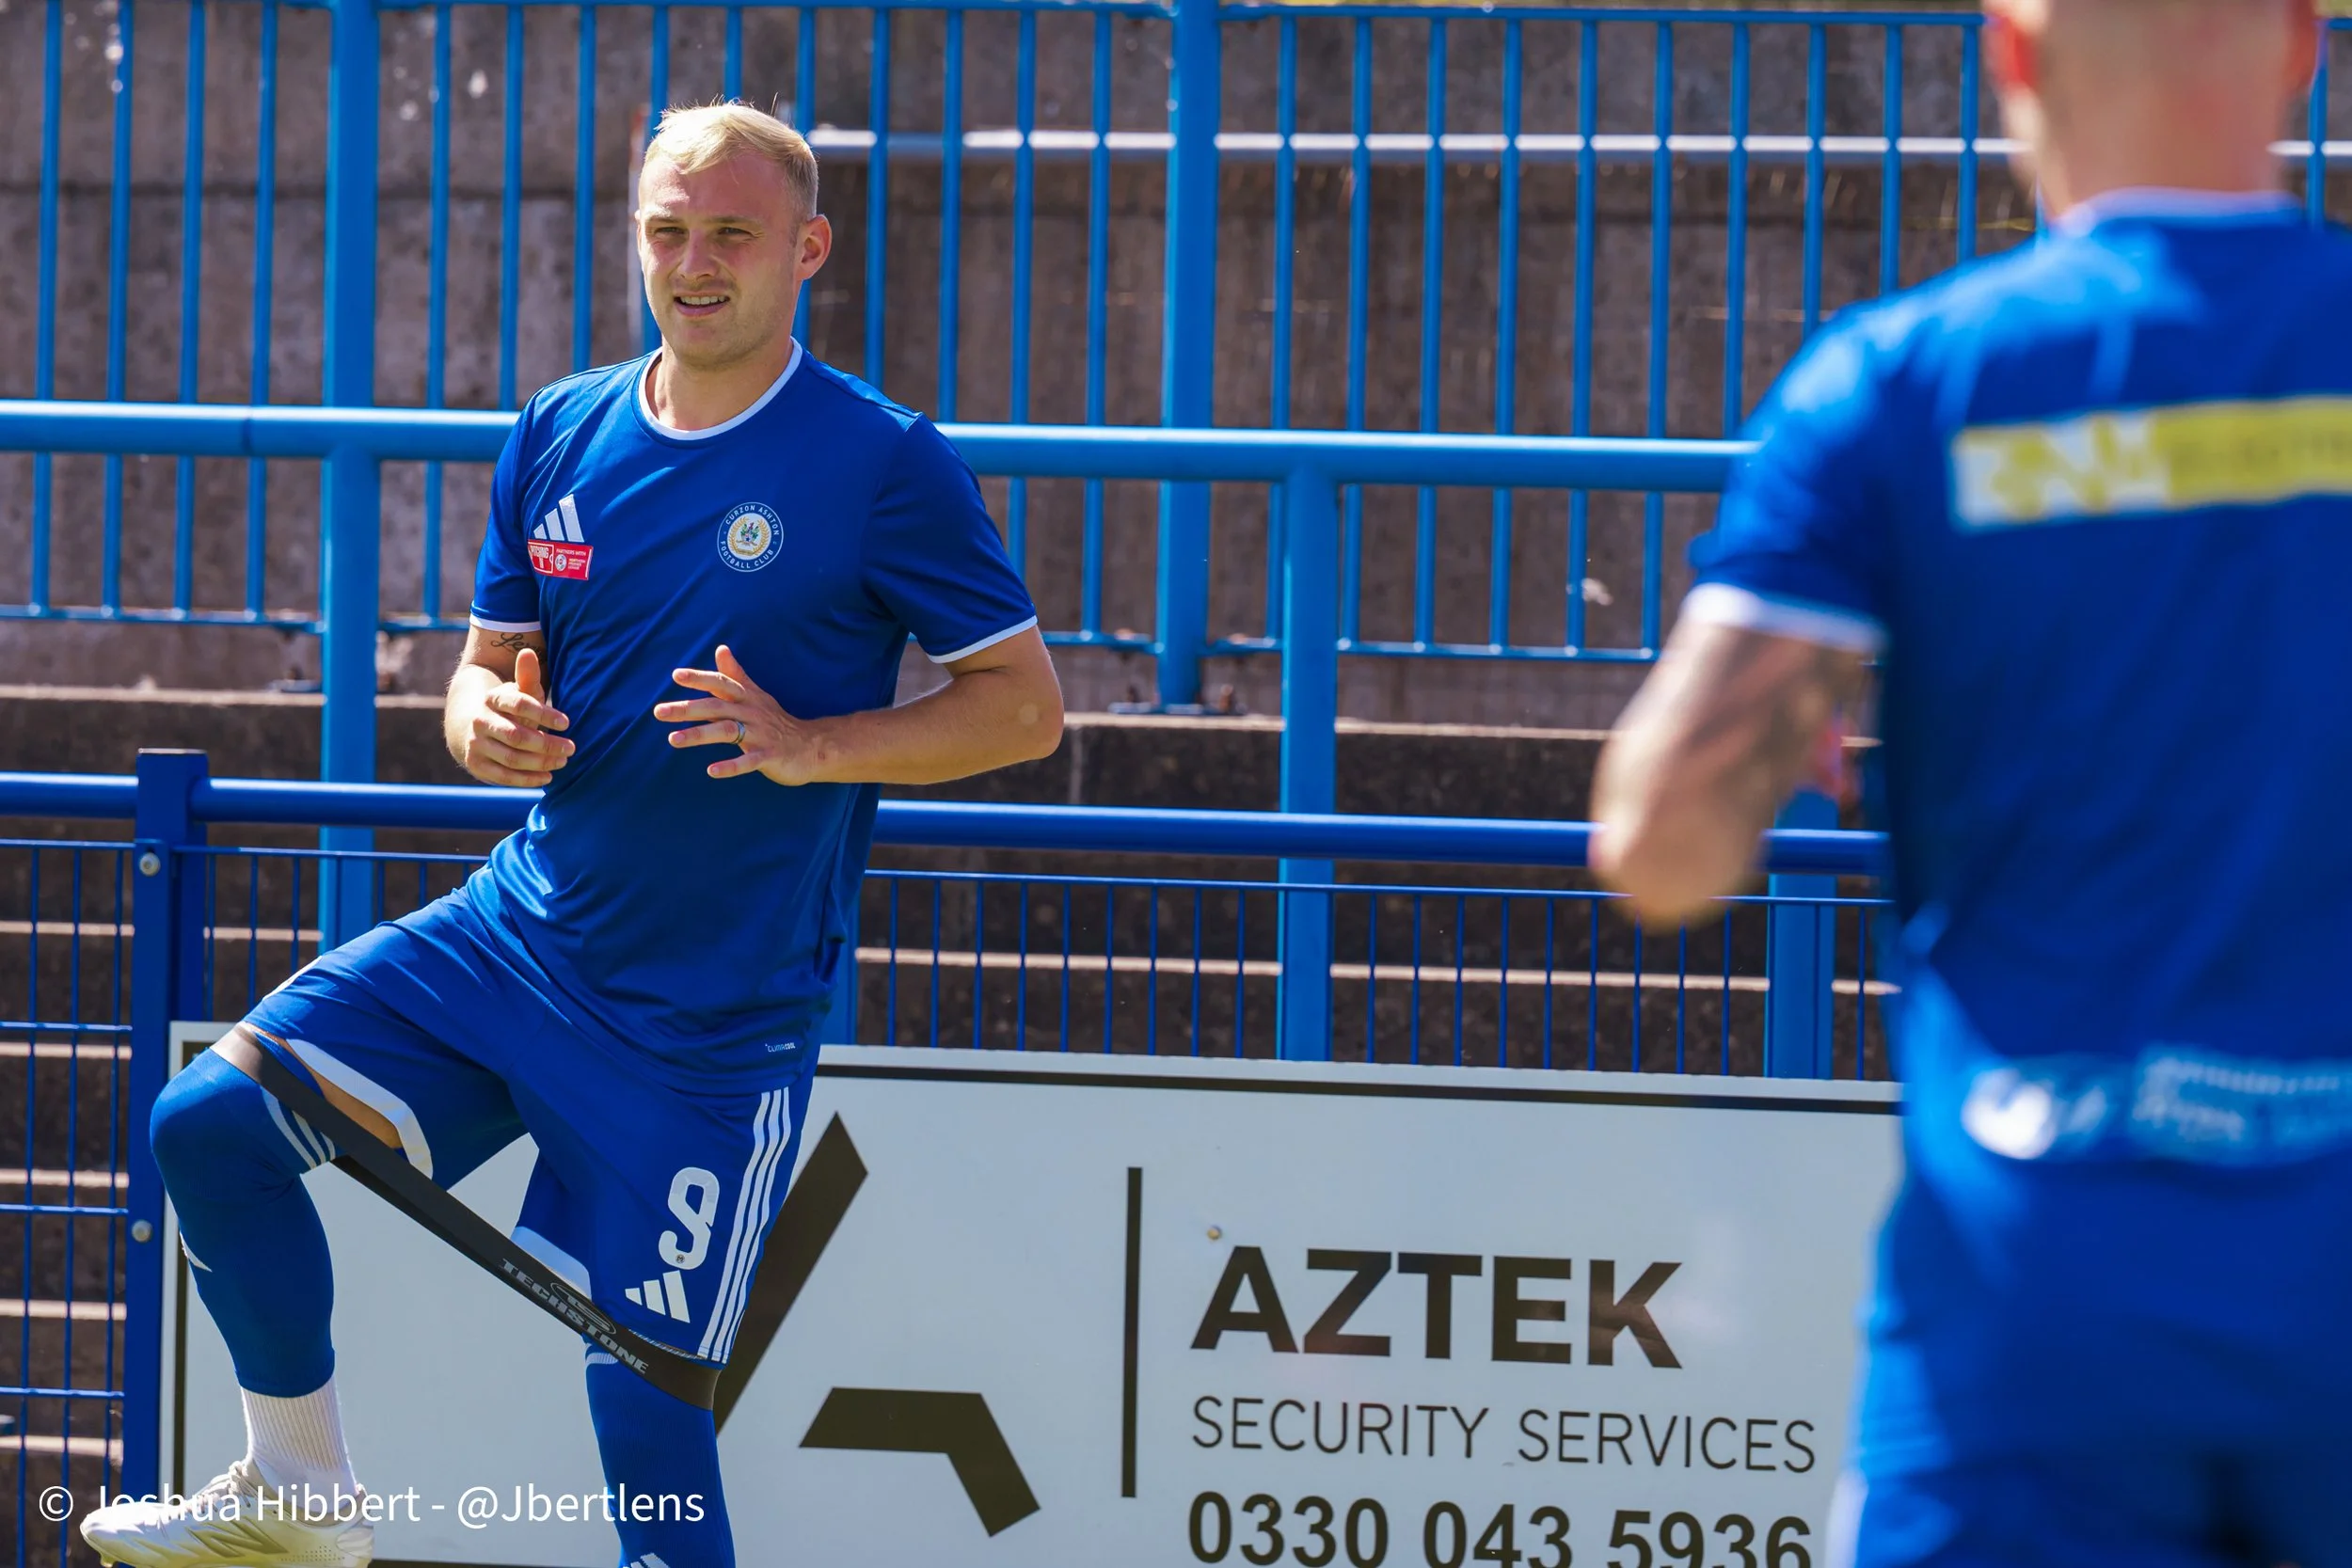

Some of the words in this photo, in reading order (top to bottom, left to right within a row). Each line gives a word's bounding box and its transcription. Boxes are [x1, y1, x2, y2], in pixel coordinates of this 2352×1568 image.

[721, 541, 751, 569] FOOTBALL
[755, 549, 773, 566] CLUB
[725, 505, 755, 525] CURZON
[758, 506, 780, 535] ASHTON
[659, 1166, 721, 1270] 9
[501, 1258, 649, 1375] TECHSTONE
[1191, 1246, 1682, 1369] AZTEK
[1193, 1396, 1489, 1459] SECURITY
[1518, 1409, 1816, 1473] SERVICES
[1189, 1491, 1389, 1568] 0330
[1423, 1501, 1573, 1568] 043
[1607, 1510, 1811, 1568] 5936
